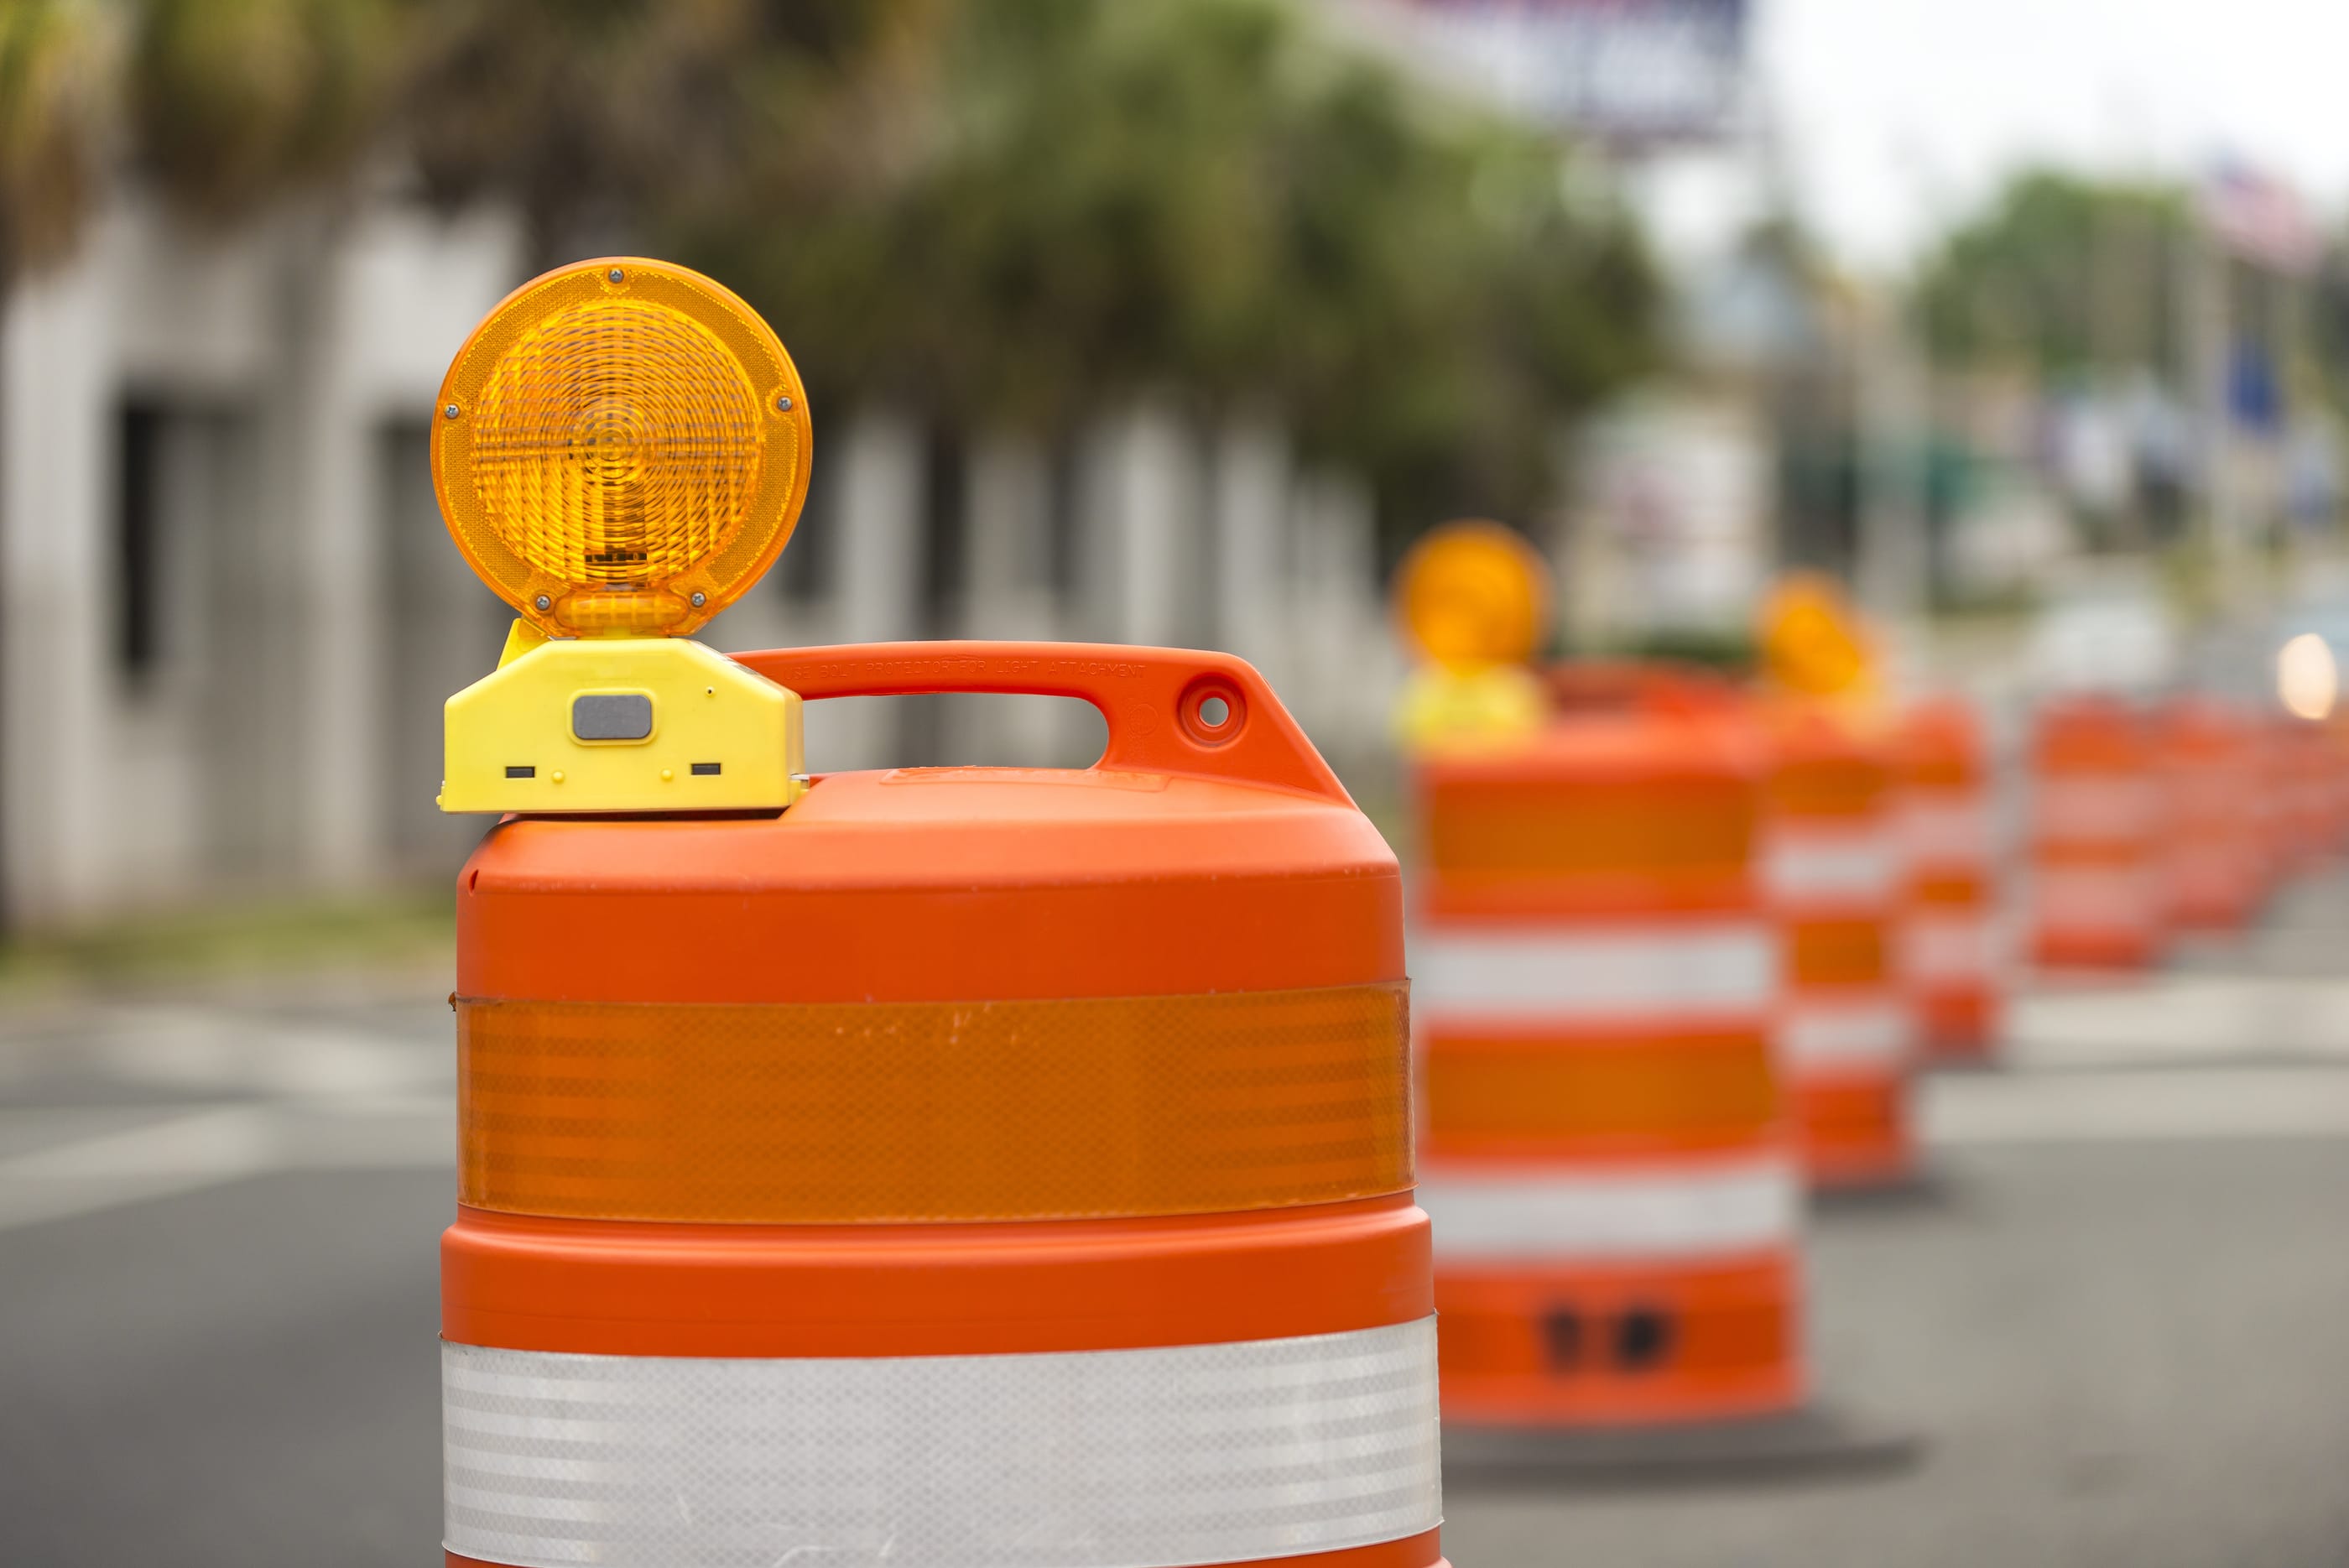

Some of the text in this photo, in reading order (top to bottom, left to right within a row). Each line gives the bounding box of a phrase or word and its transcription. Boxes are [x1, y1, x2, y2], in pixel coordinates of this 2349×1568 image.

[784, 659, 1148, 680] USE BOLT PROTECTOR FOR LIGHT ATTACHMENT
